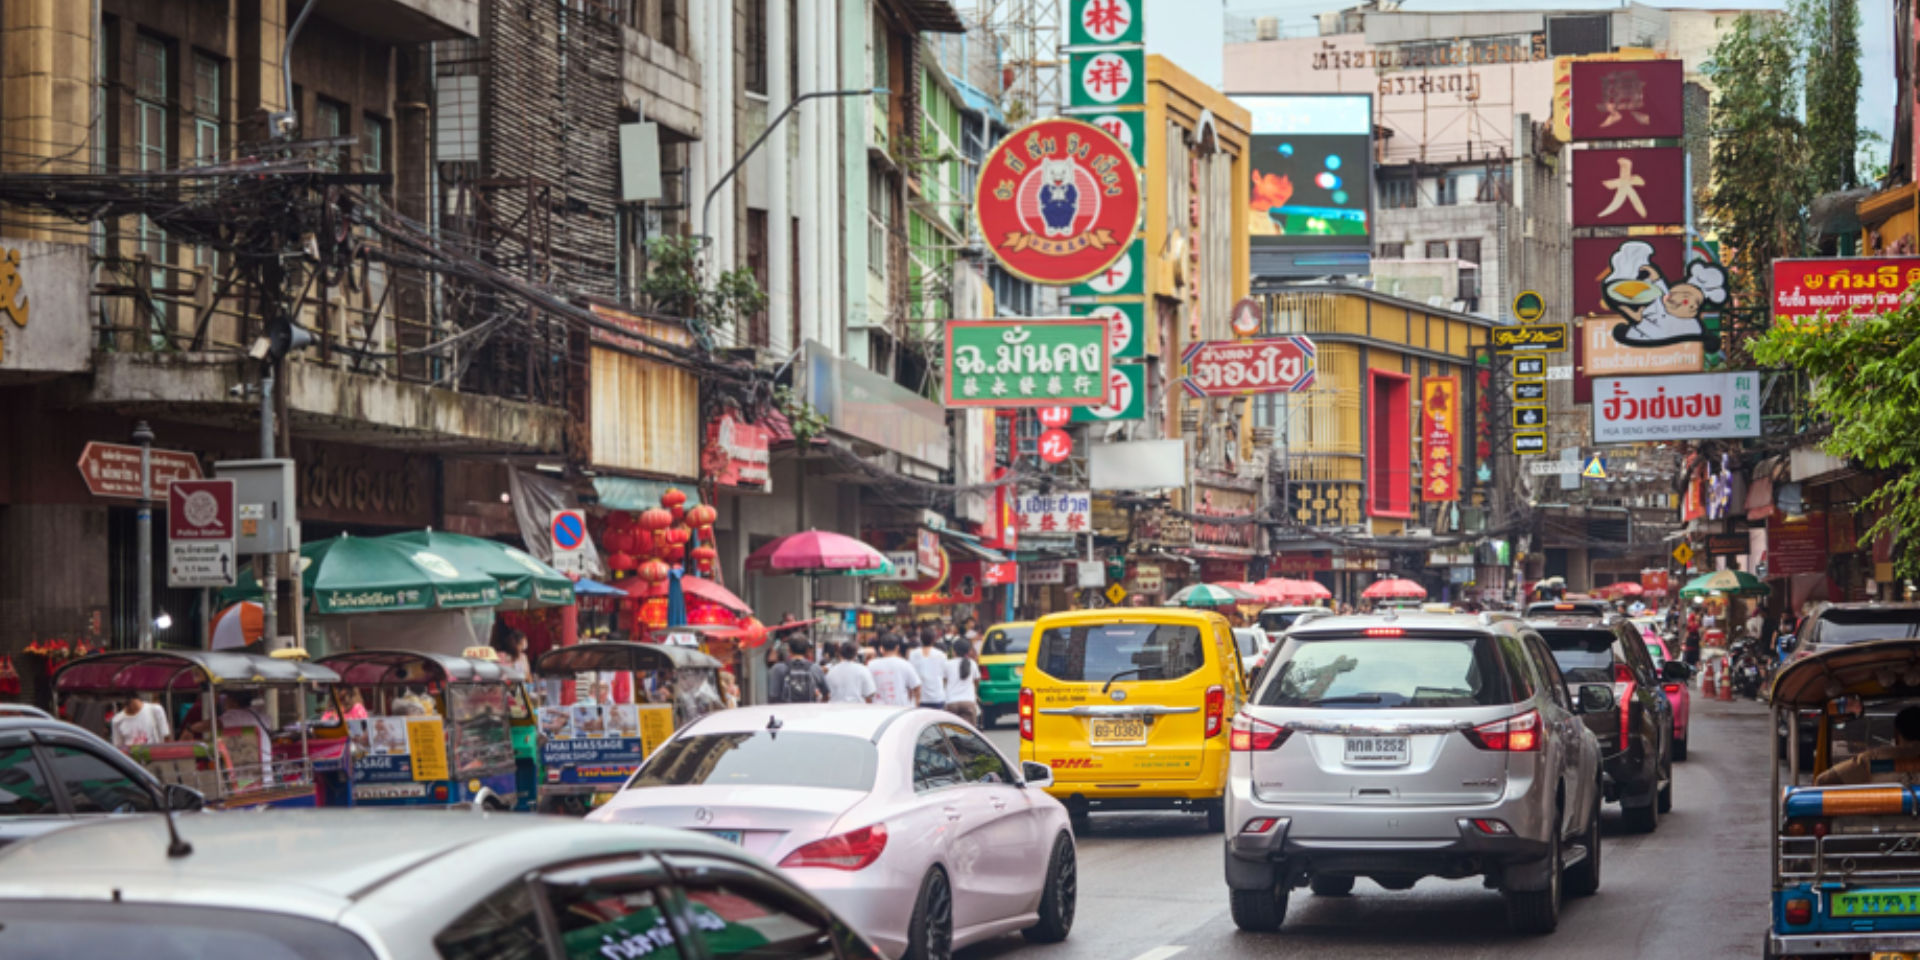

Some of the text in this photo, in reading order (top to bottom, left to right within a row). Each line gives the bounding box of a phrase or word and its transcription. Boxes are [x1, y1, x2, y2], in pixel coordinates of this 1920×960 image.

[1084, 0, 1129, 36] 林
[1086, 58, 1129, 96] 祥
[1597, 156, 1648, 219] 大
[955, 325, 1100, 374] ฉ.มั่นคง
[1603, 381, 1723, 421] ฮั่วเซ่งฮง
[1603, 422, 1722, 436] HUA SENG HONG RESTAURANT
[177, 529, 198, 537] Police
[544, 751, 599, 762] WORKSHOP
[572, 740, 624, 751] MASSAGE
[1050, 759, 1092, 768] DHL
